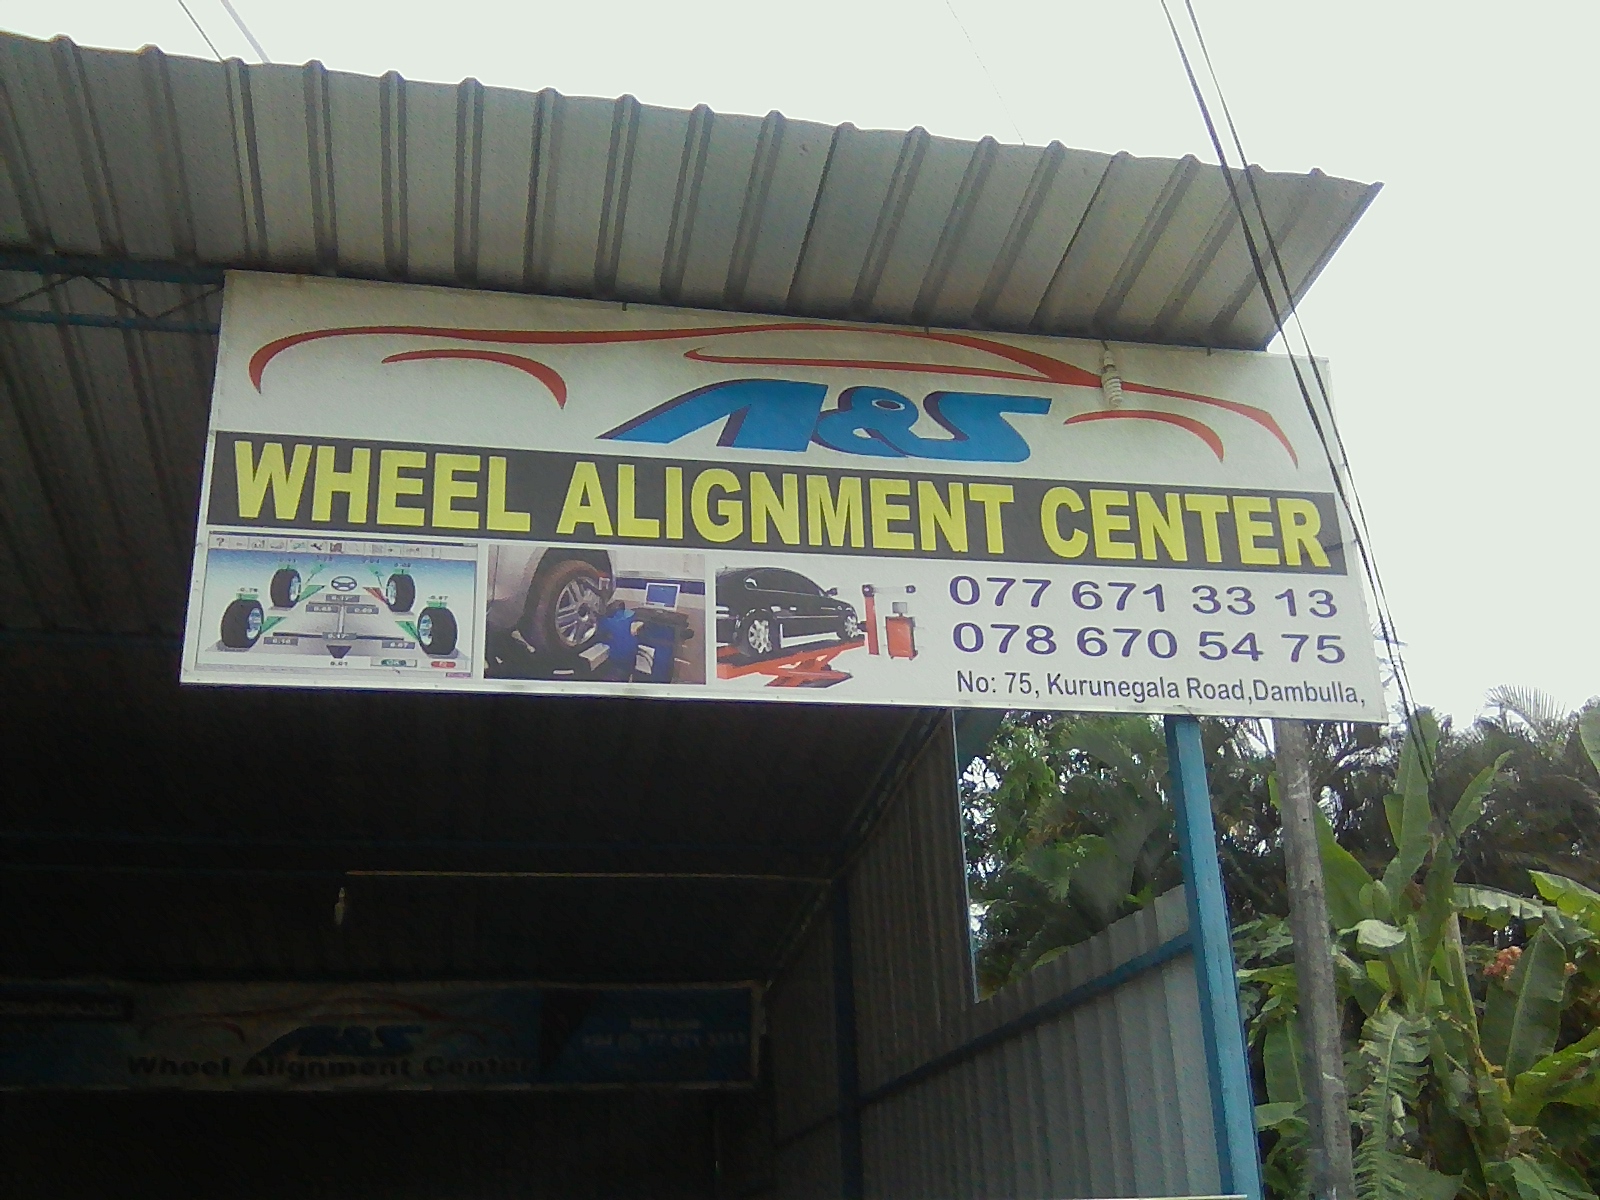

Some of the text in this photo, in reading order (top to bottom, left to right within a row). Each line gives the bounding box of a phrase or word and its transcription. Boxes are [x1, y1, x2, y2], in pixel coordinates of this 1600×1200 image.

[595, 379, 1052, 463] A&S
[236, 442, 1331, 568] WHEEL ALIGNMENT CENTER
[950, 576, 1337, 617] 077 671 33 13
[953, 623, 1344, 663] 078 670 54 75
[957, 671, 997, 694] No:
[1005, 672, 1039, 698] 75,
[1047, 673, 1179, 703] Kurunegala
